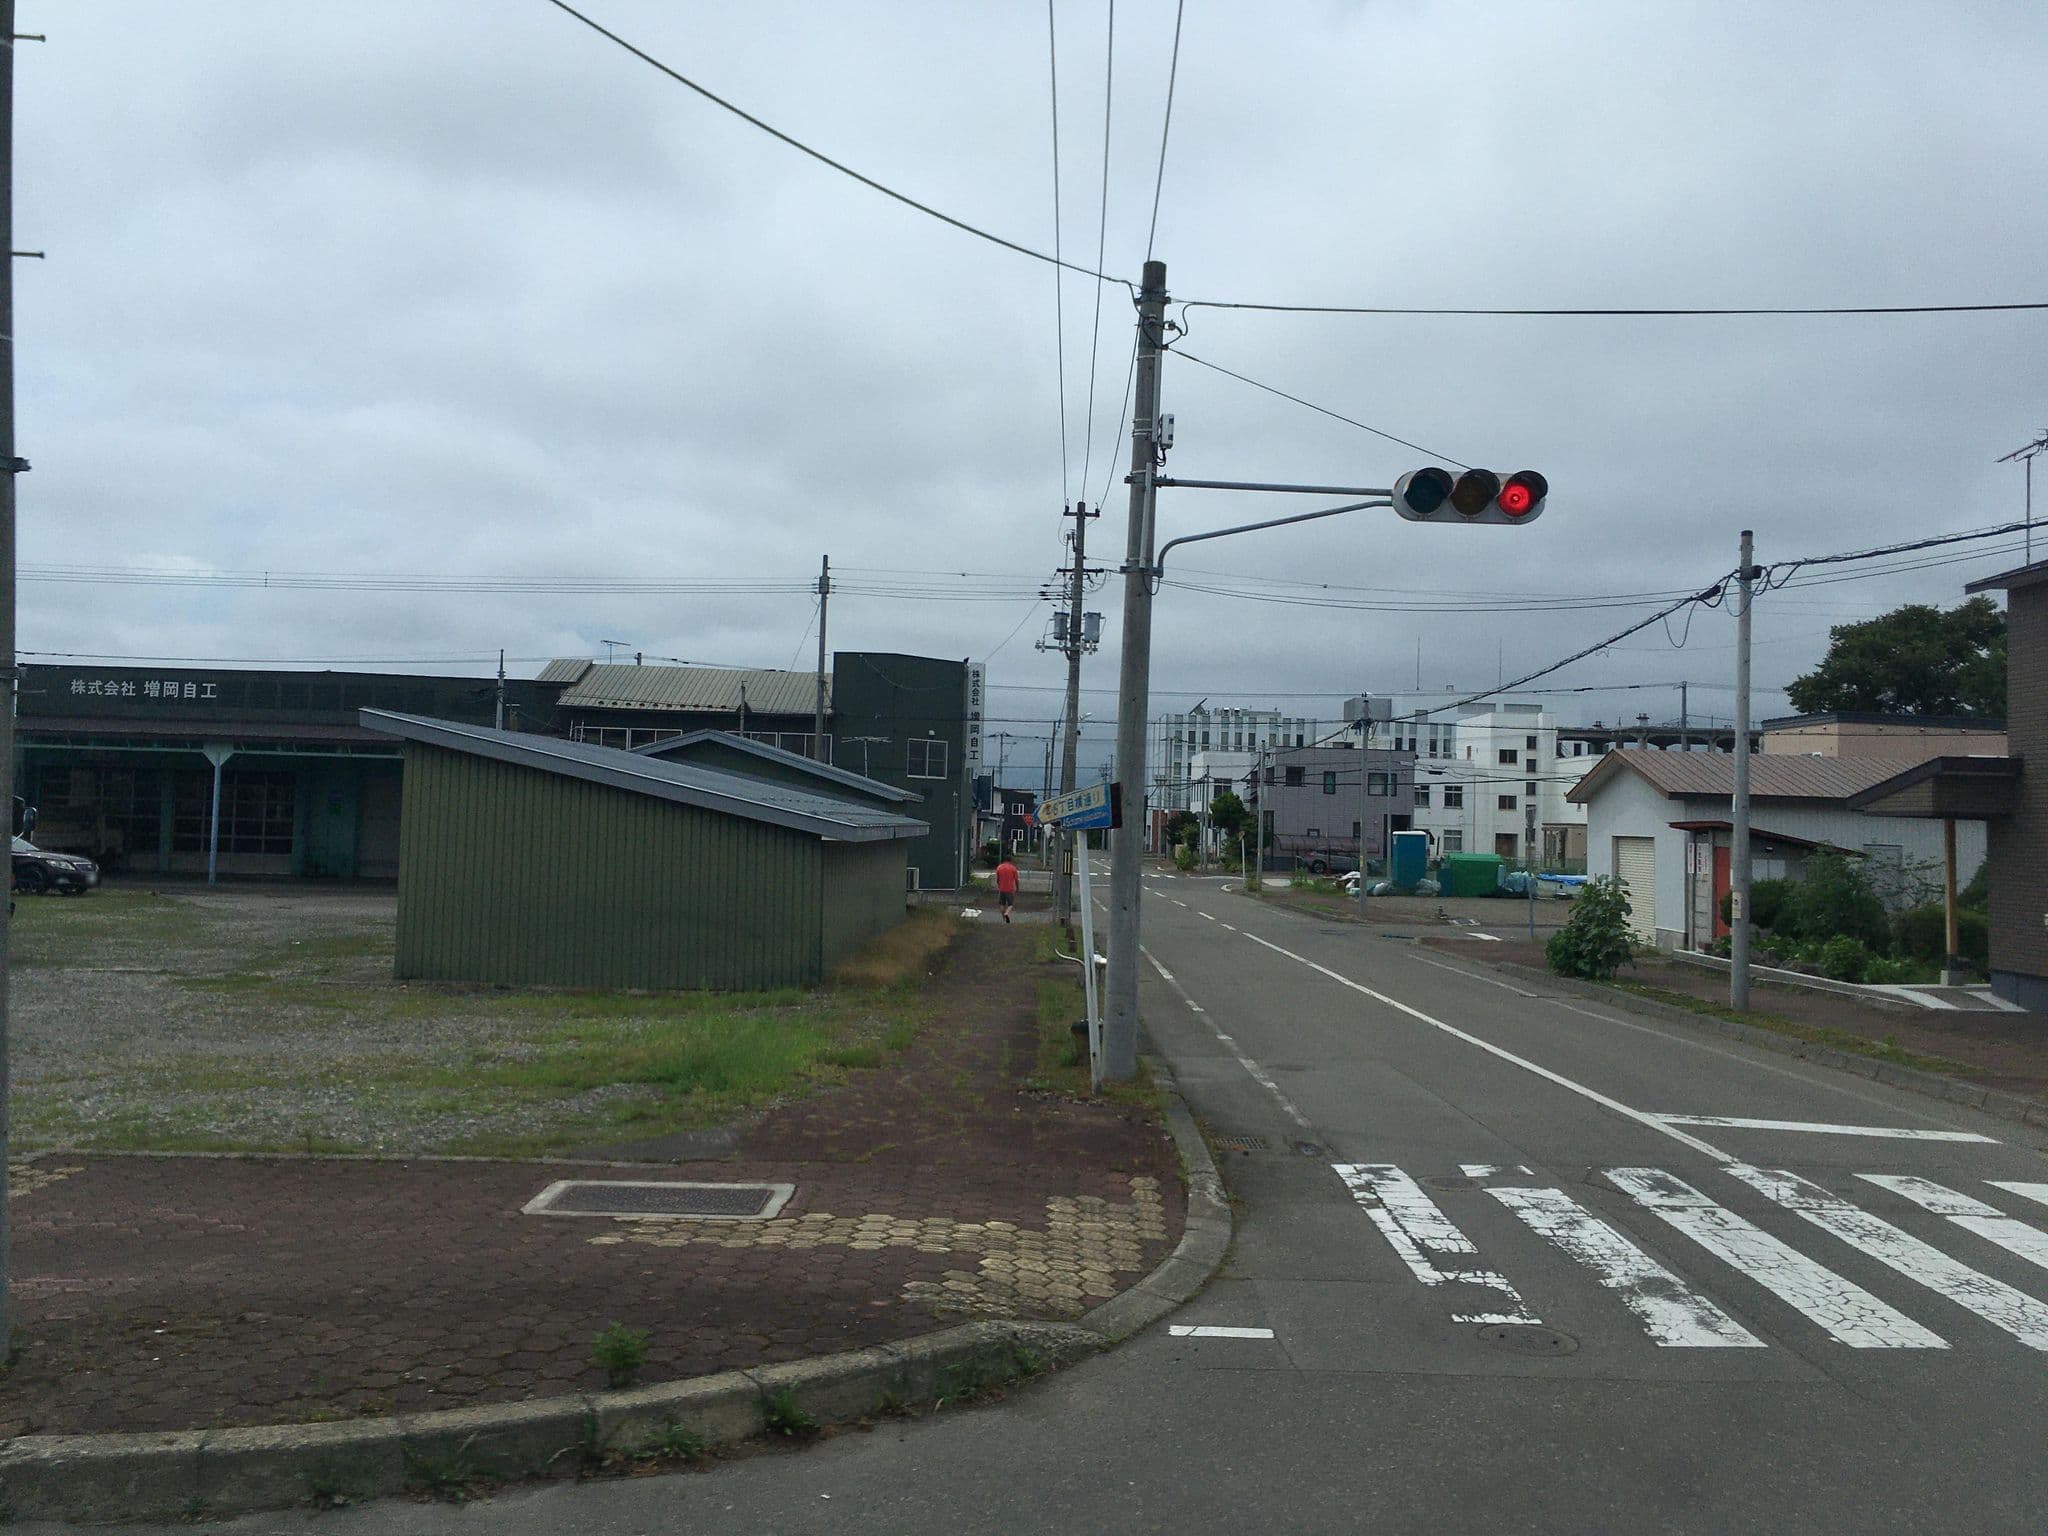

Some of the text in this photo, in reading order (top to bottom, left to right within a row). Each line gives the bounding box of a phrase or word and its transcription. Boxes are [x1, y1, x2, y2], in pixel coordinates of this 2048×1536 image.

[70, 679, 217, 698] 株式会社 増岡自工
[969, 669, 981, 760] 株式会社 増岡自工
